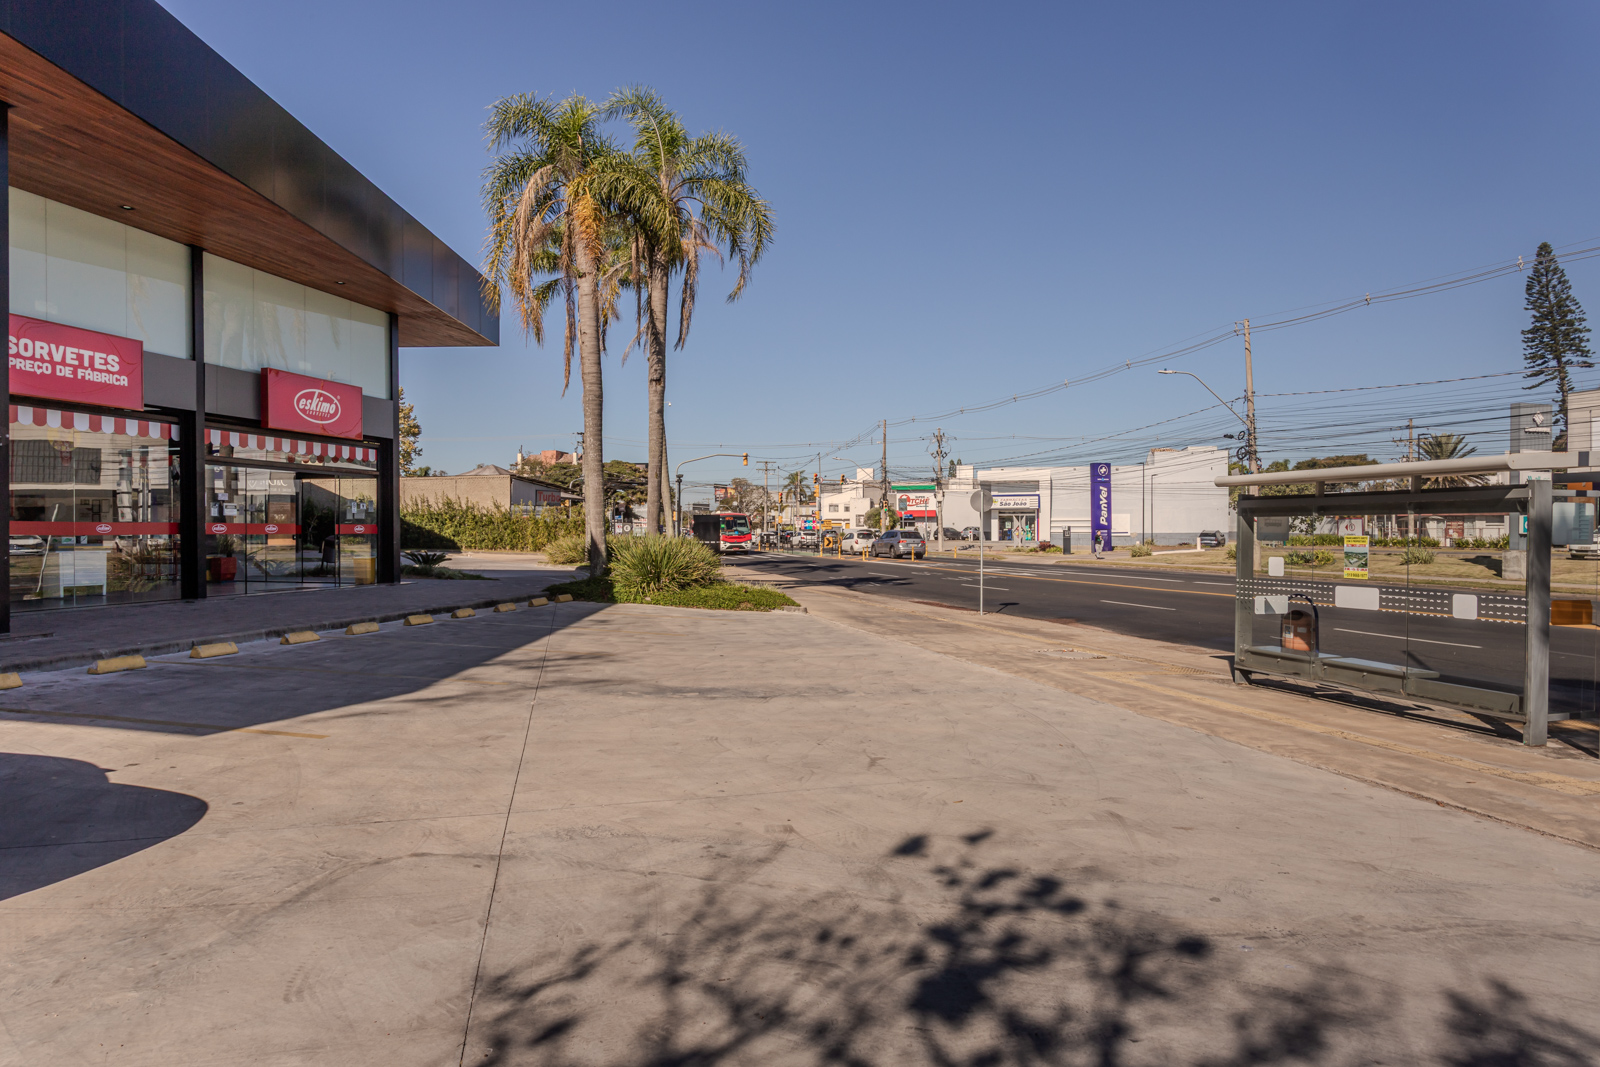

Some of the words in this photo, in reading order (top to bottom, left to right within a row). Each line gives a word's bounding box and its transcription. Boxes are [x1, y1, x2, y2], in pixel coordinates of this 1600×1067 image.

[9, 335, 120, 372] SORVETES
[9, 356, 52, 375] PREÇO
[56, 364, 73, 378] DE
[77, 367, 128, 387] FÁBRICA
